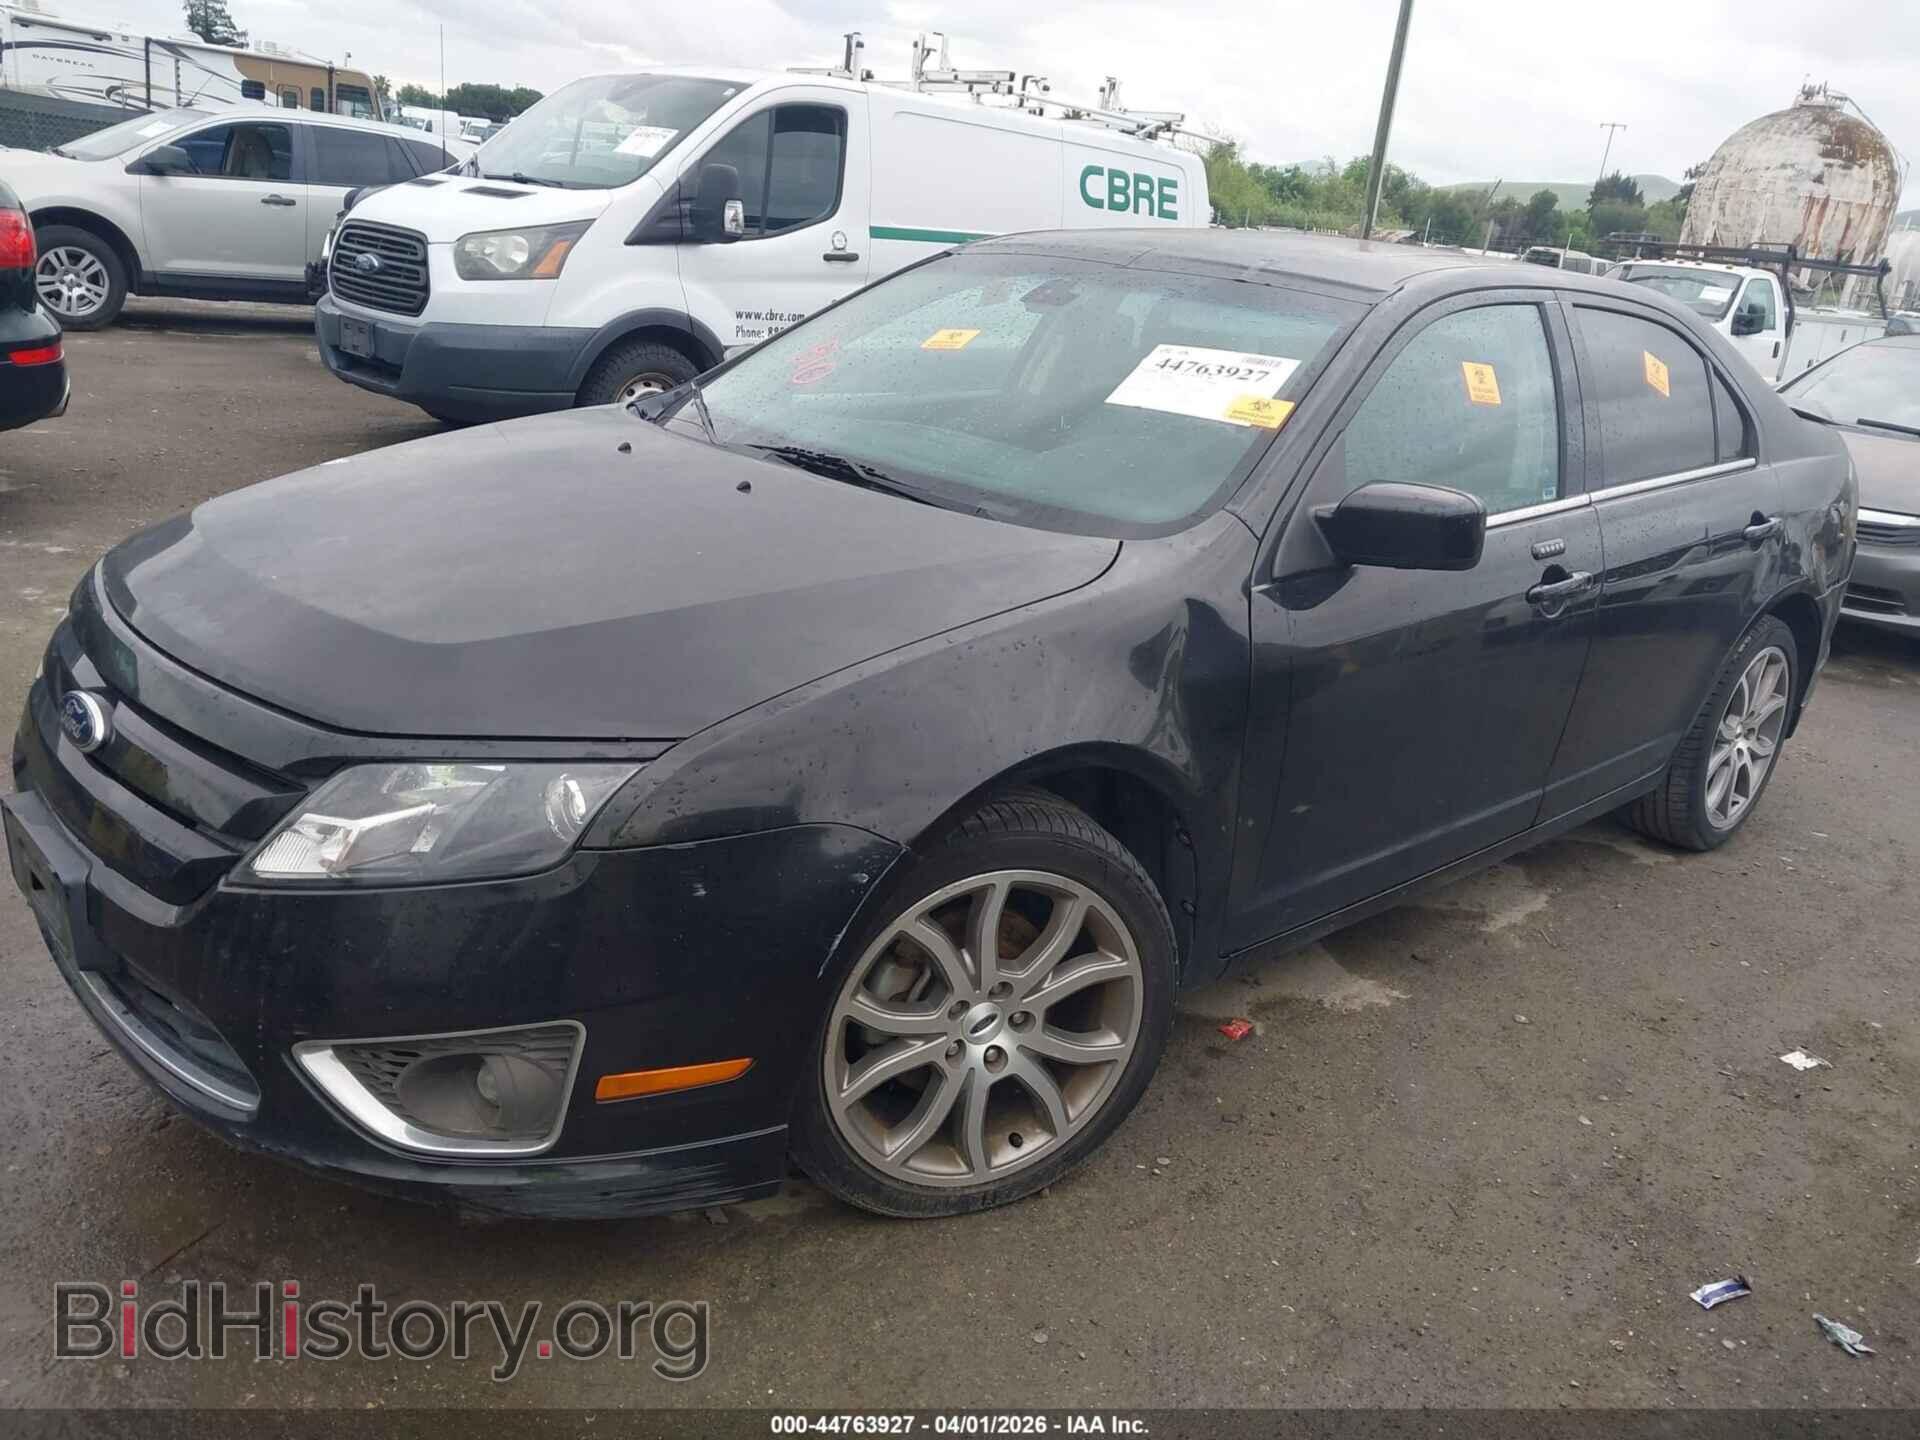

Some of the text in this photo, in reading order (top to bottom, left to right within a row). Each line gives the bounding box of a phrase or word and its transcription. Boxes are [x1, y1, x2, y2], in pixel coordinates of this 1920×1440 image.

[1080, 165, 1178, 220] CBRE
[735, 308, 805, 322] www.cbre.com
[735, 325, 765, 338] Phone:
[1155, 357, 1270, 383] 44763927
